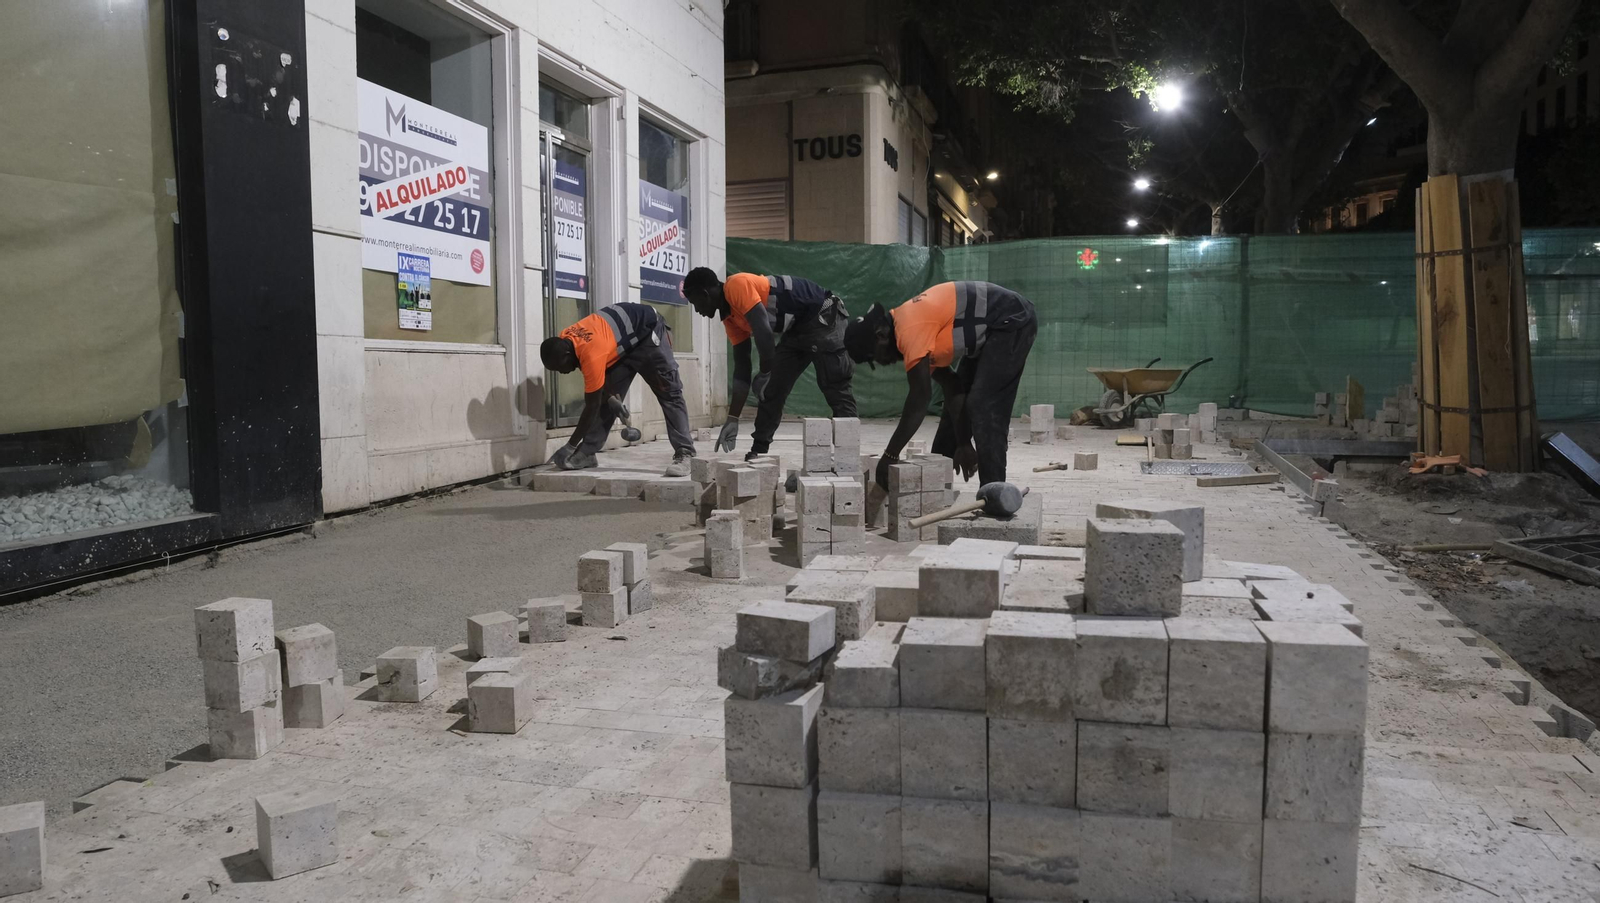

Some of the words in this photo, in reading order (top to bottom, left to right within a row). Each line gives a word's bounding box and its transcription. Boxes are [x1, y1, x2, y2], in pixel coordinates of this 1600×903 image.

[407, 119, 458, 141] MONTERREAL
[794, 134, 862, 162] TOUS
[376, 166, 467, 213] ALQUILADO
[433, 199, 455, 230] 25
[461, 207, 481, 235] 17
[557, 221, 565, 237] 27
[566, 223, 575, 239] 25
[575, 226, 583, 241] 17
[398, 255, 409, 270] IX
[663, 251, 673, 271] 25
[676, 254, 686, 273] 17
